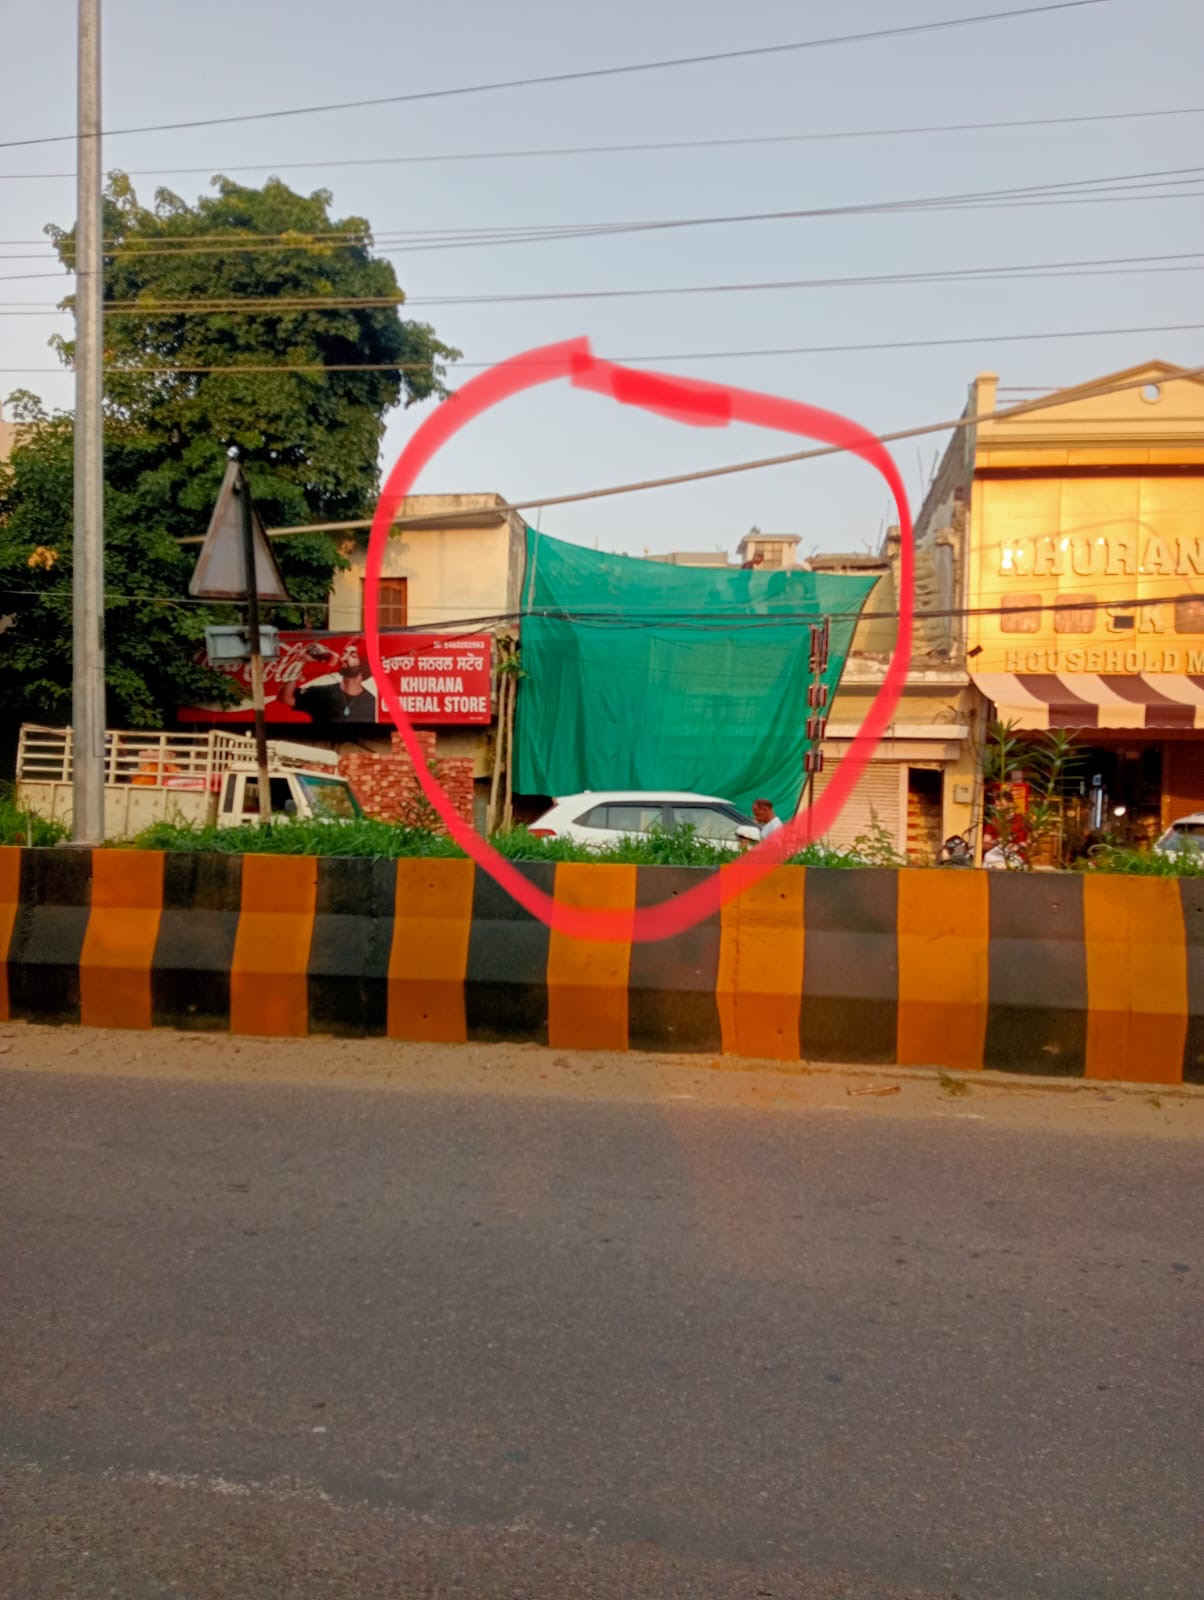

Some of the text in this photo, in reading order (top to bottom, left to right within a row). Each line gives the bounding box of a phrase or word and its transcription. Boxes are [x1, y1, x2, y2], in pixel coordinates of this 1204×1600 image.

[418, 656, 454, 671] ਜਨਰਲ
[1004, 649, 1180, 673] HOUSEHOLD
[400, 676, 464, 693] KHURANA
[381, 696, 487, 713] GNERAL STORE
